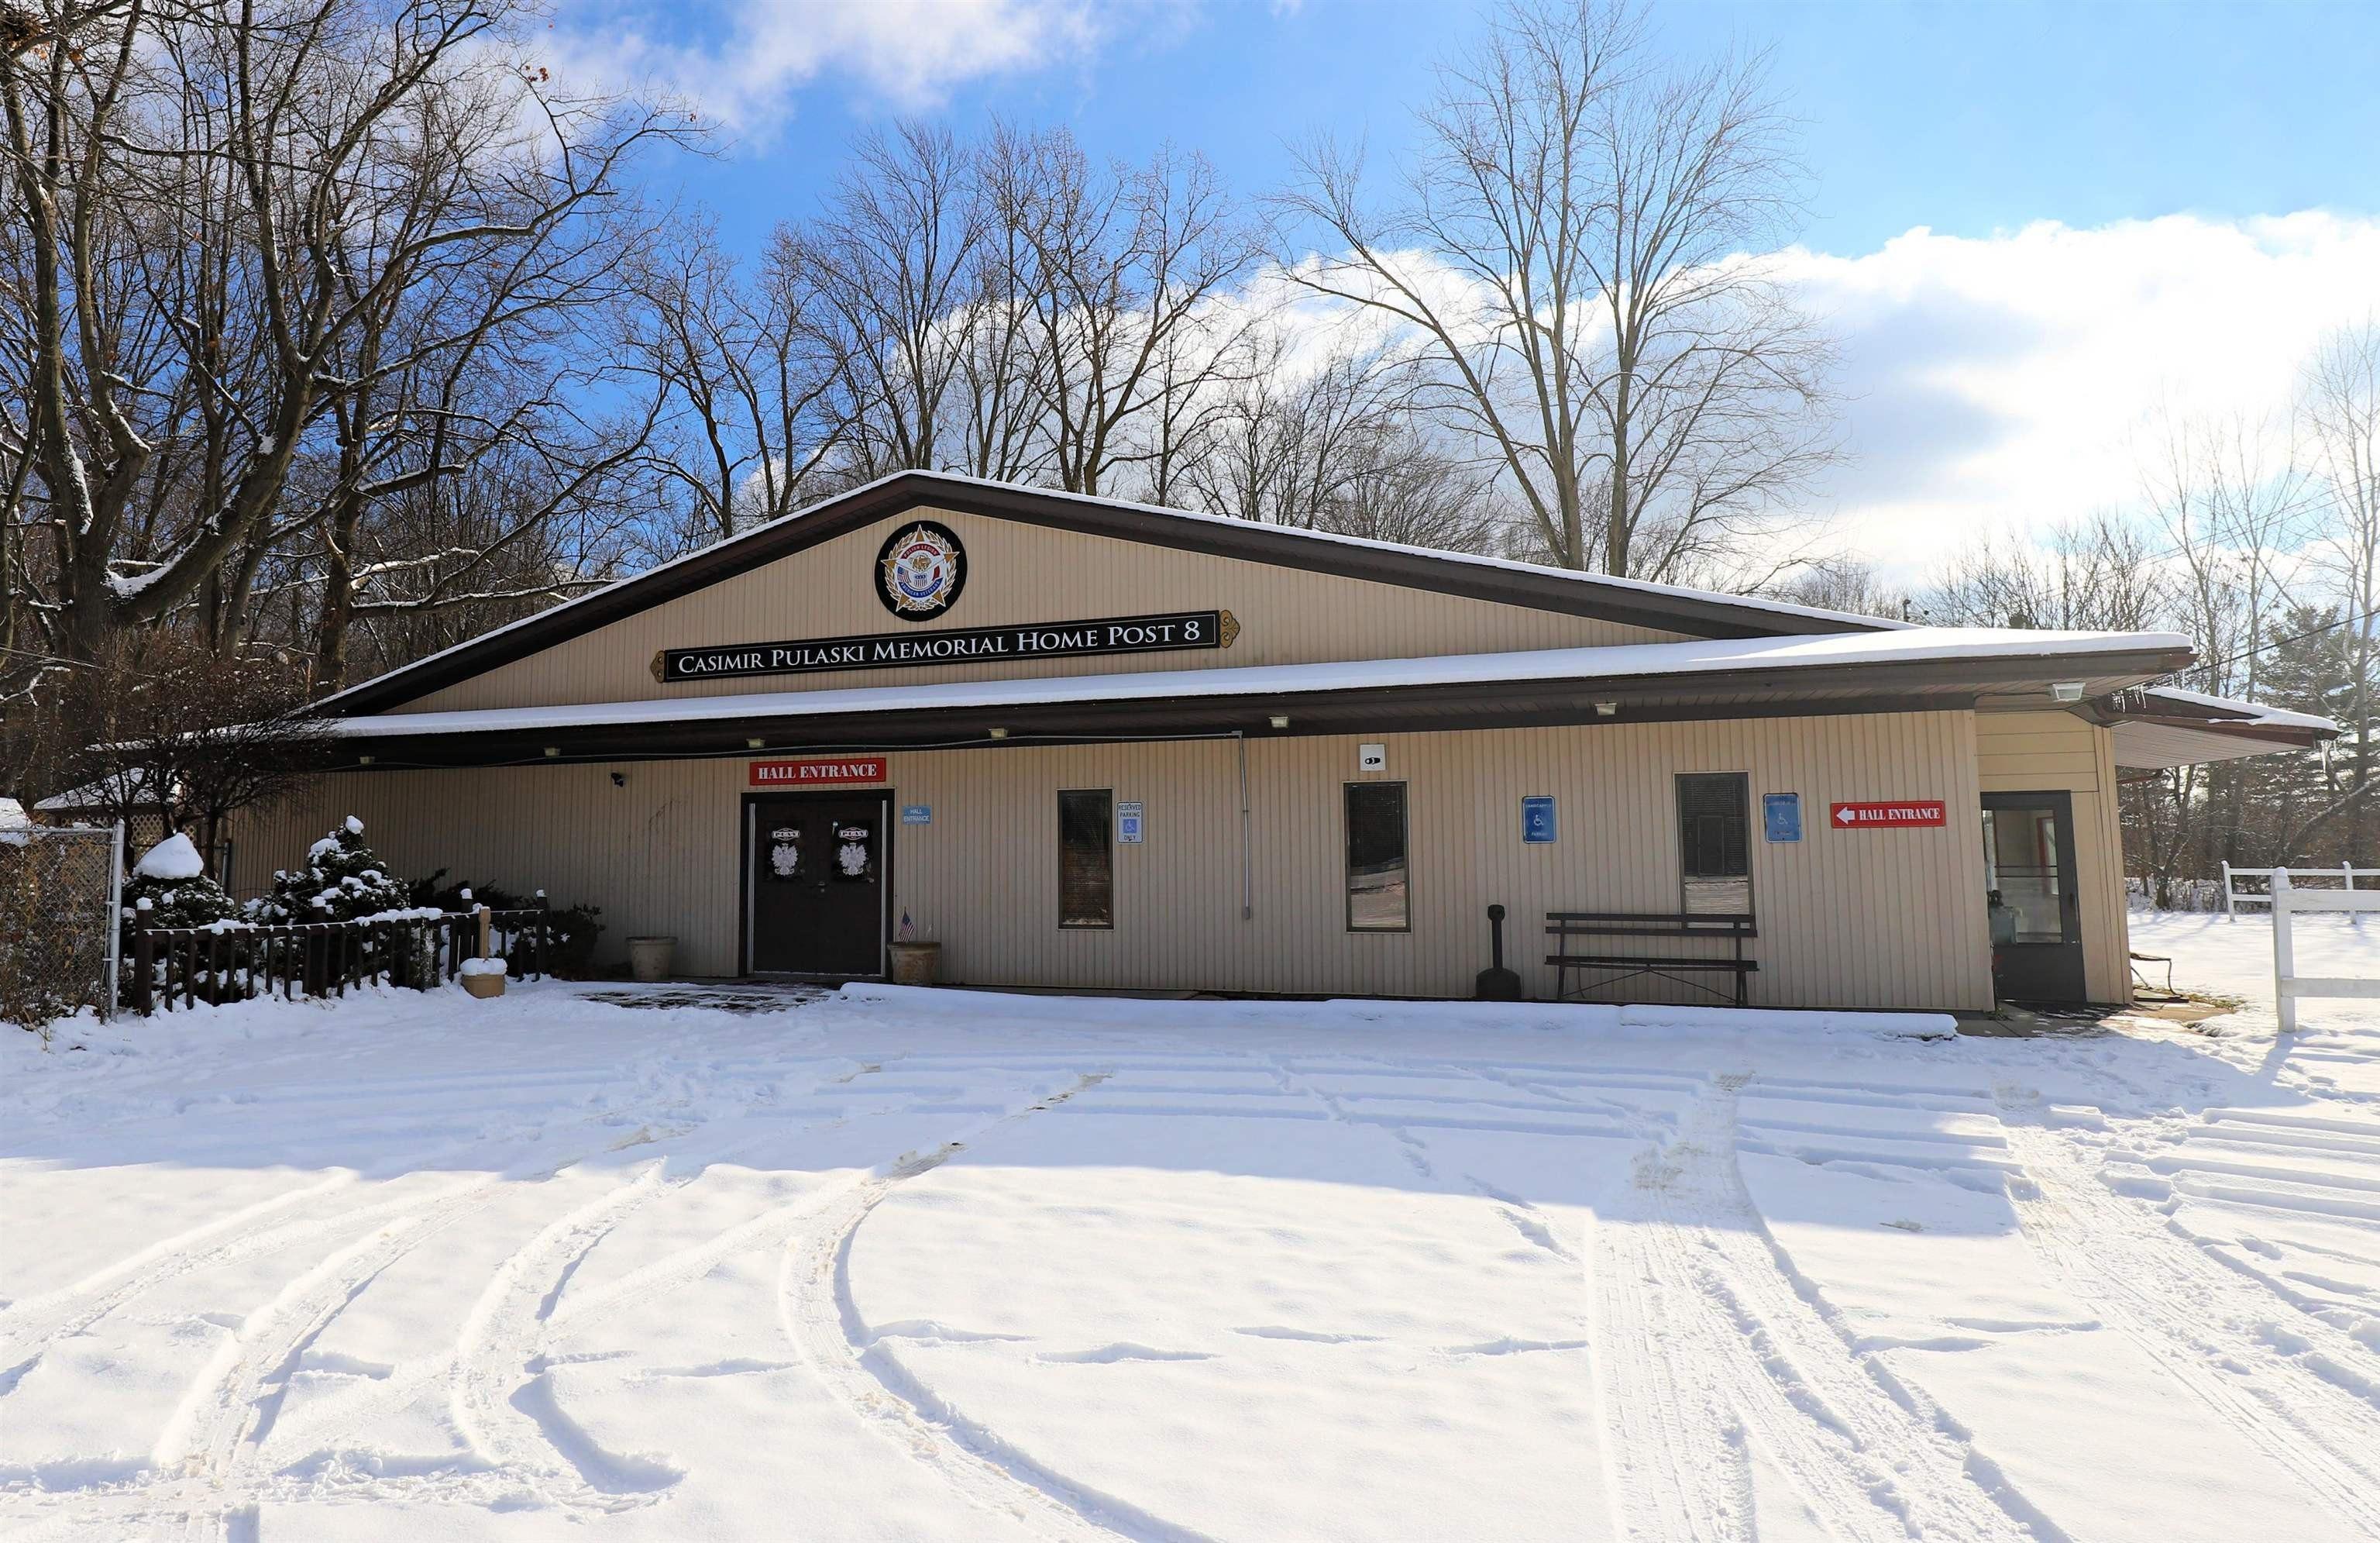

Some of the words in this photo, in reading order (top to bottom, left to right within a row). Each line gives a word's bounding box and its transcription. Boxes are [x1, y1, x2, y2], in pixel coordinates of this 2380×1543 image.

[678, 653, 765, 673] CASIMIR
[771, 646, 865, 666] PULASKI
[872, 636, 1009, 660] MEMORIAL
[1016, 630, 1099, 651] HOME
[1106, 625, 1176, 646] POST
[1183, 621, 1201, 641] 8
[758, 766, 796, 780] HALL
[799, 763, 877, 778] ENTRANCE
[1859, 809, 1886, 821] HALL
[1888, 808, 1941, 820] ENTRANCE
